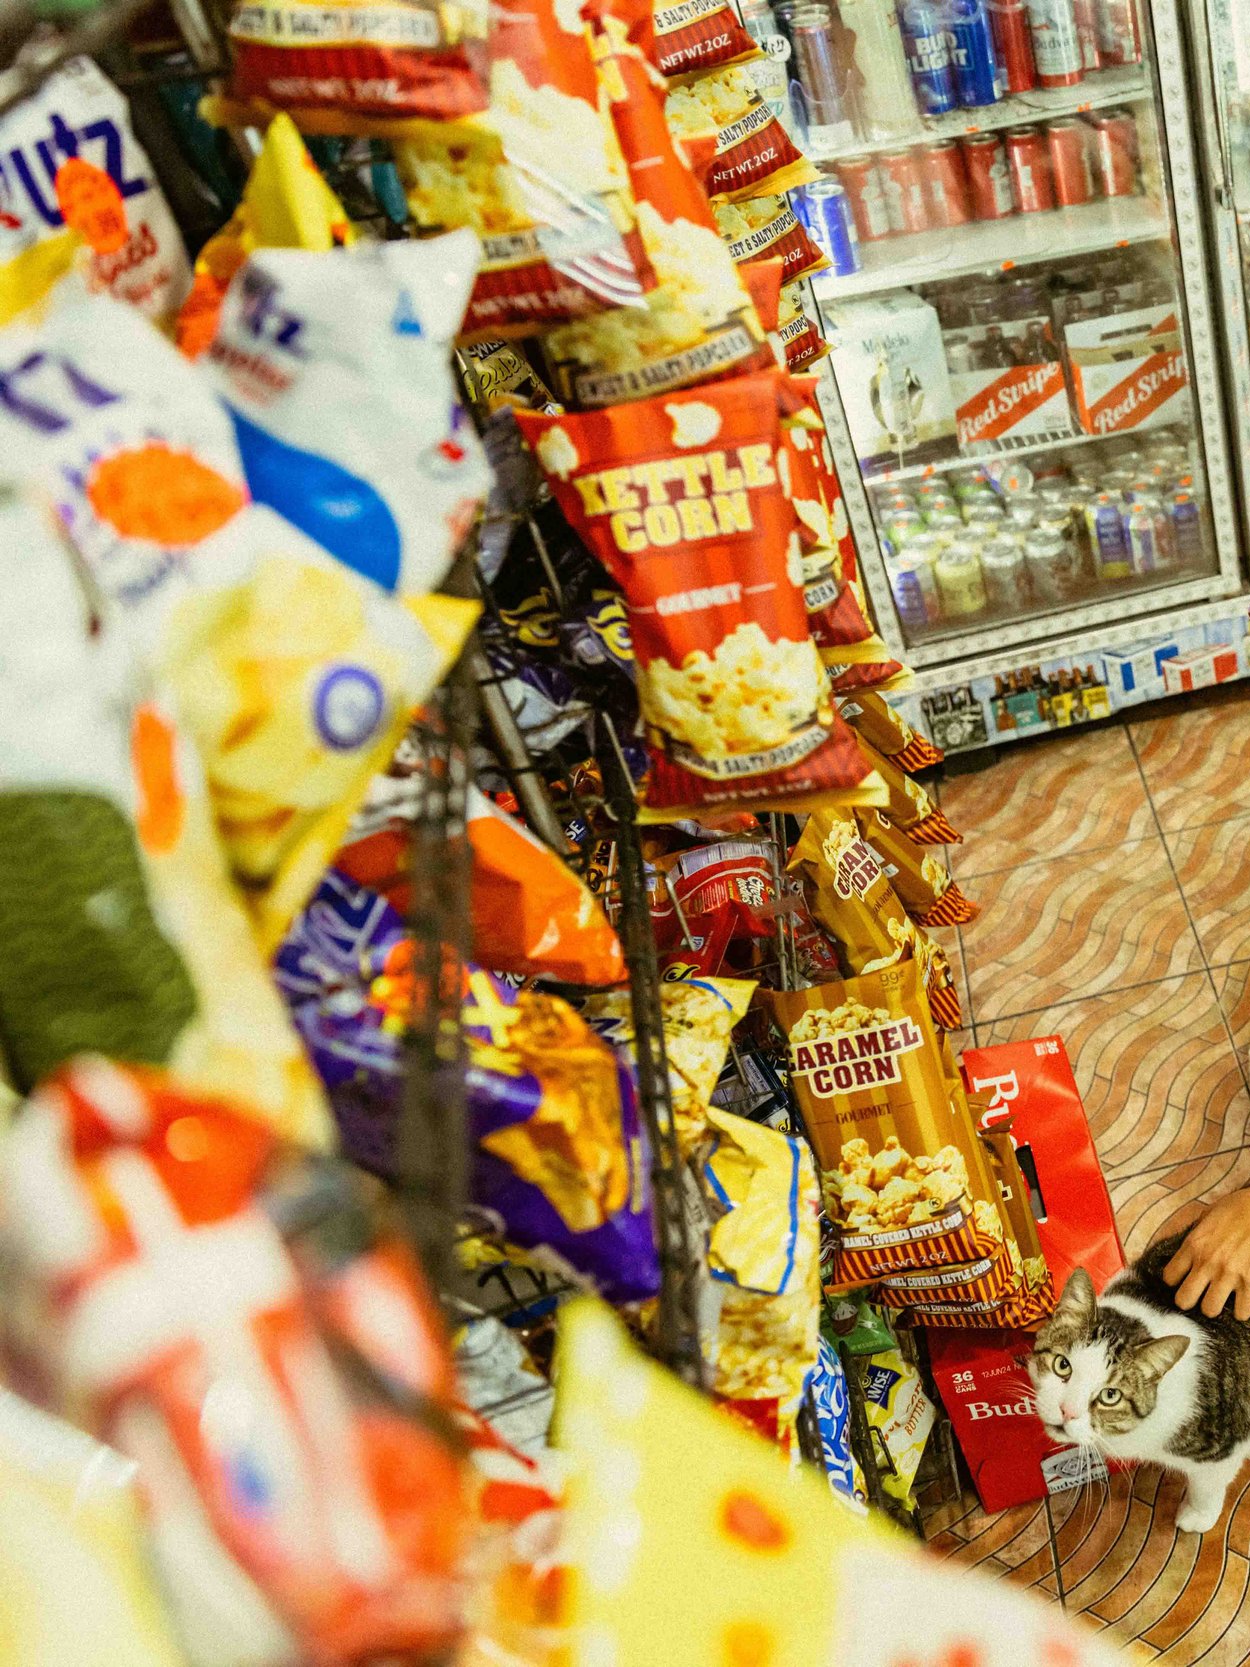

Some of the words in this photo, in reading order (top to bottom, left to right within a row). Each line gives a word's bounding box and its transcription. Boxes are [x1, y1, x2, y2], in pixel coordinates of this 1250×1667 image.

[664, 4, 698, 27] SALTY
[660, 50, 686, 70] NET
[718, 125, 744, 148] SALTY
[713, 167, 735, 183] NET
[752, 227, 773, 249] SALTY
[959, 408, 997, 443] Red
[998, 361, 1062, 411] Stripe
[1094, 395, 1136, 433] Red
[573, 442, 777, 517] KETTLE
[610, 490, 753, 554] CORN
[787, 1022, 919, 1073] ARAMEL
[813, 1055, 896, 1094] CORN
[835, 1103, 893, 1125] GOURMET
[873, 1229, 911, 1245] COVERED
[909, 1220, 942, 1239] KETTLE
[942, 1210, 964, 1229] CORN
[869, 1260, 894, 1272] NET
[907, 1275, 941, 1287] COVERED
[941, 1268, 972, 1284] KETTLE
[971, 1258, 992, 1276] CORN
[867, 1370, 891, 1399] WISE
[952, 1370, 975, 1385] 36
[955, 1385, 977, 1394] CANS
[904, 1397, 927, 1436] BUTTER
